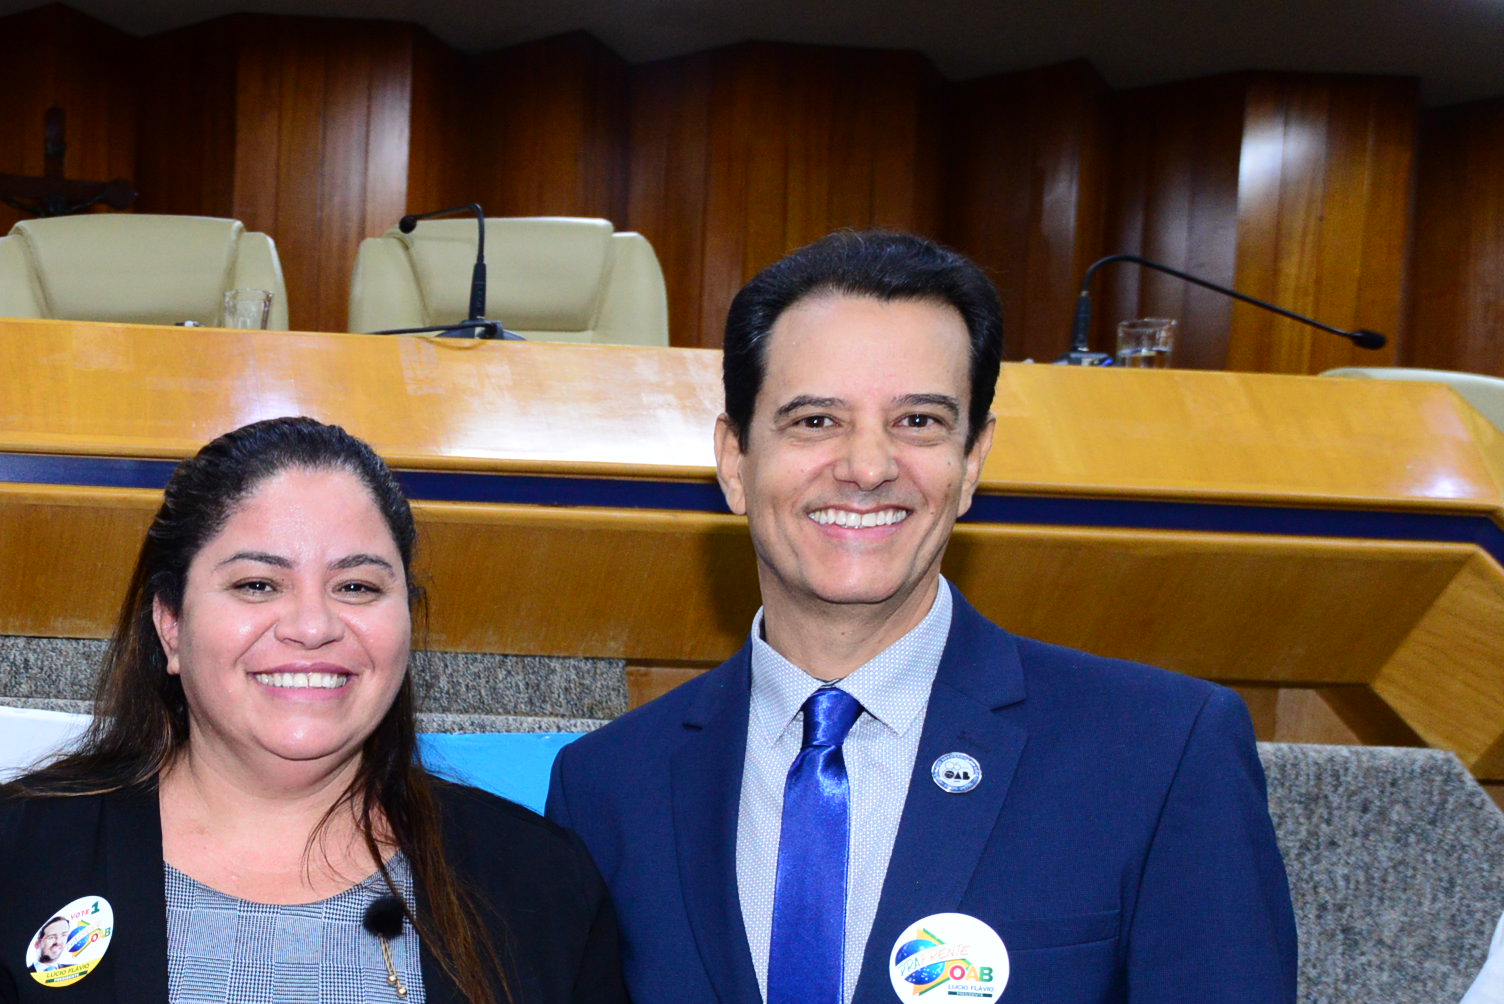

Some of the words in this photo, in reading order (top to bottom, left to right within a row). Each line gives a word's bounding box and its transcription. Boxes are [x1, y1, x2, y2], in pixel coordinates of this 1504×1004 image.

[944, 770, 970, 780] OAB
[70, 908, 90, 919] VOTE
[91, 901, 100, 915] 1
[949, 964, 994, 982] OAB
